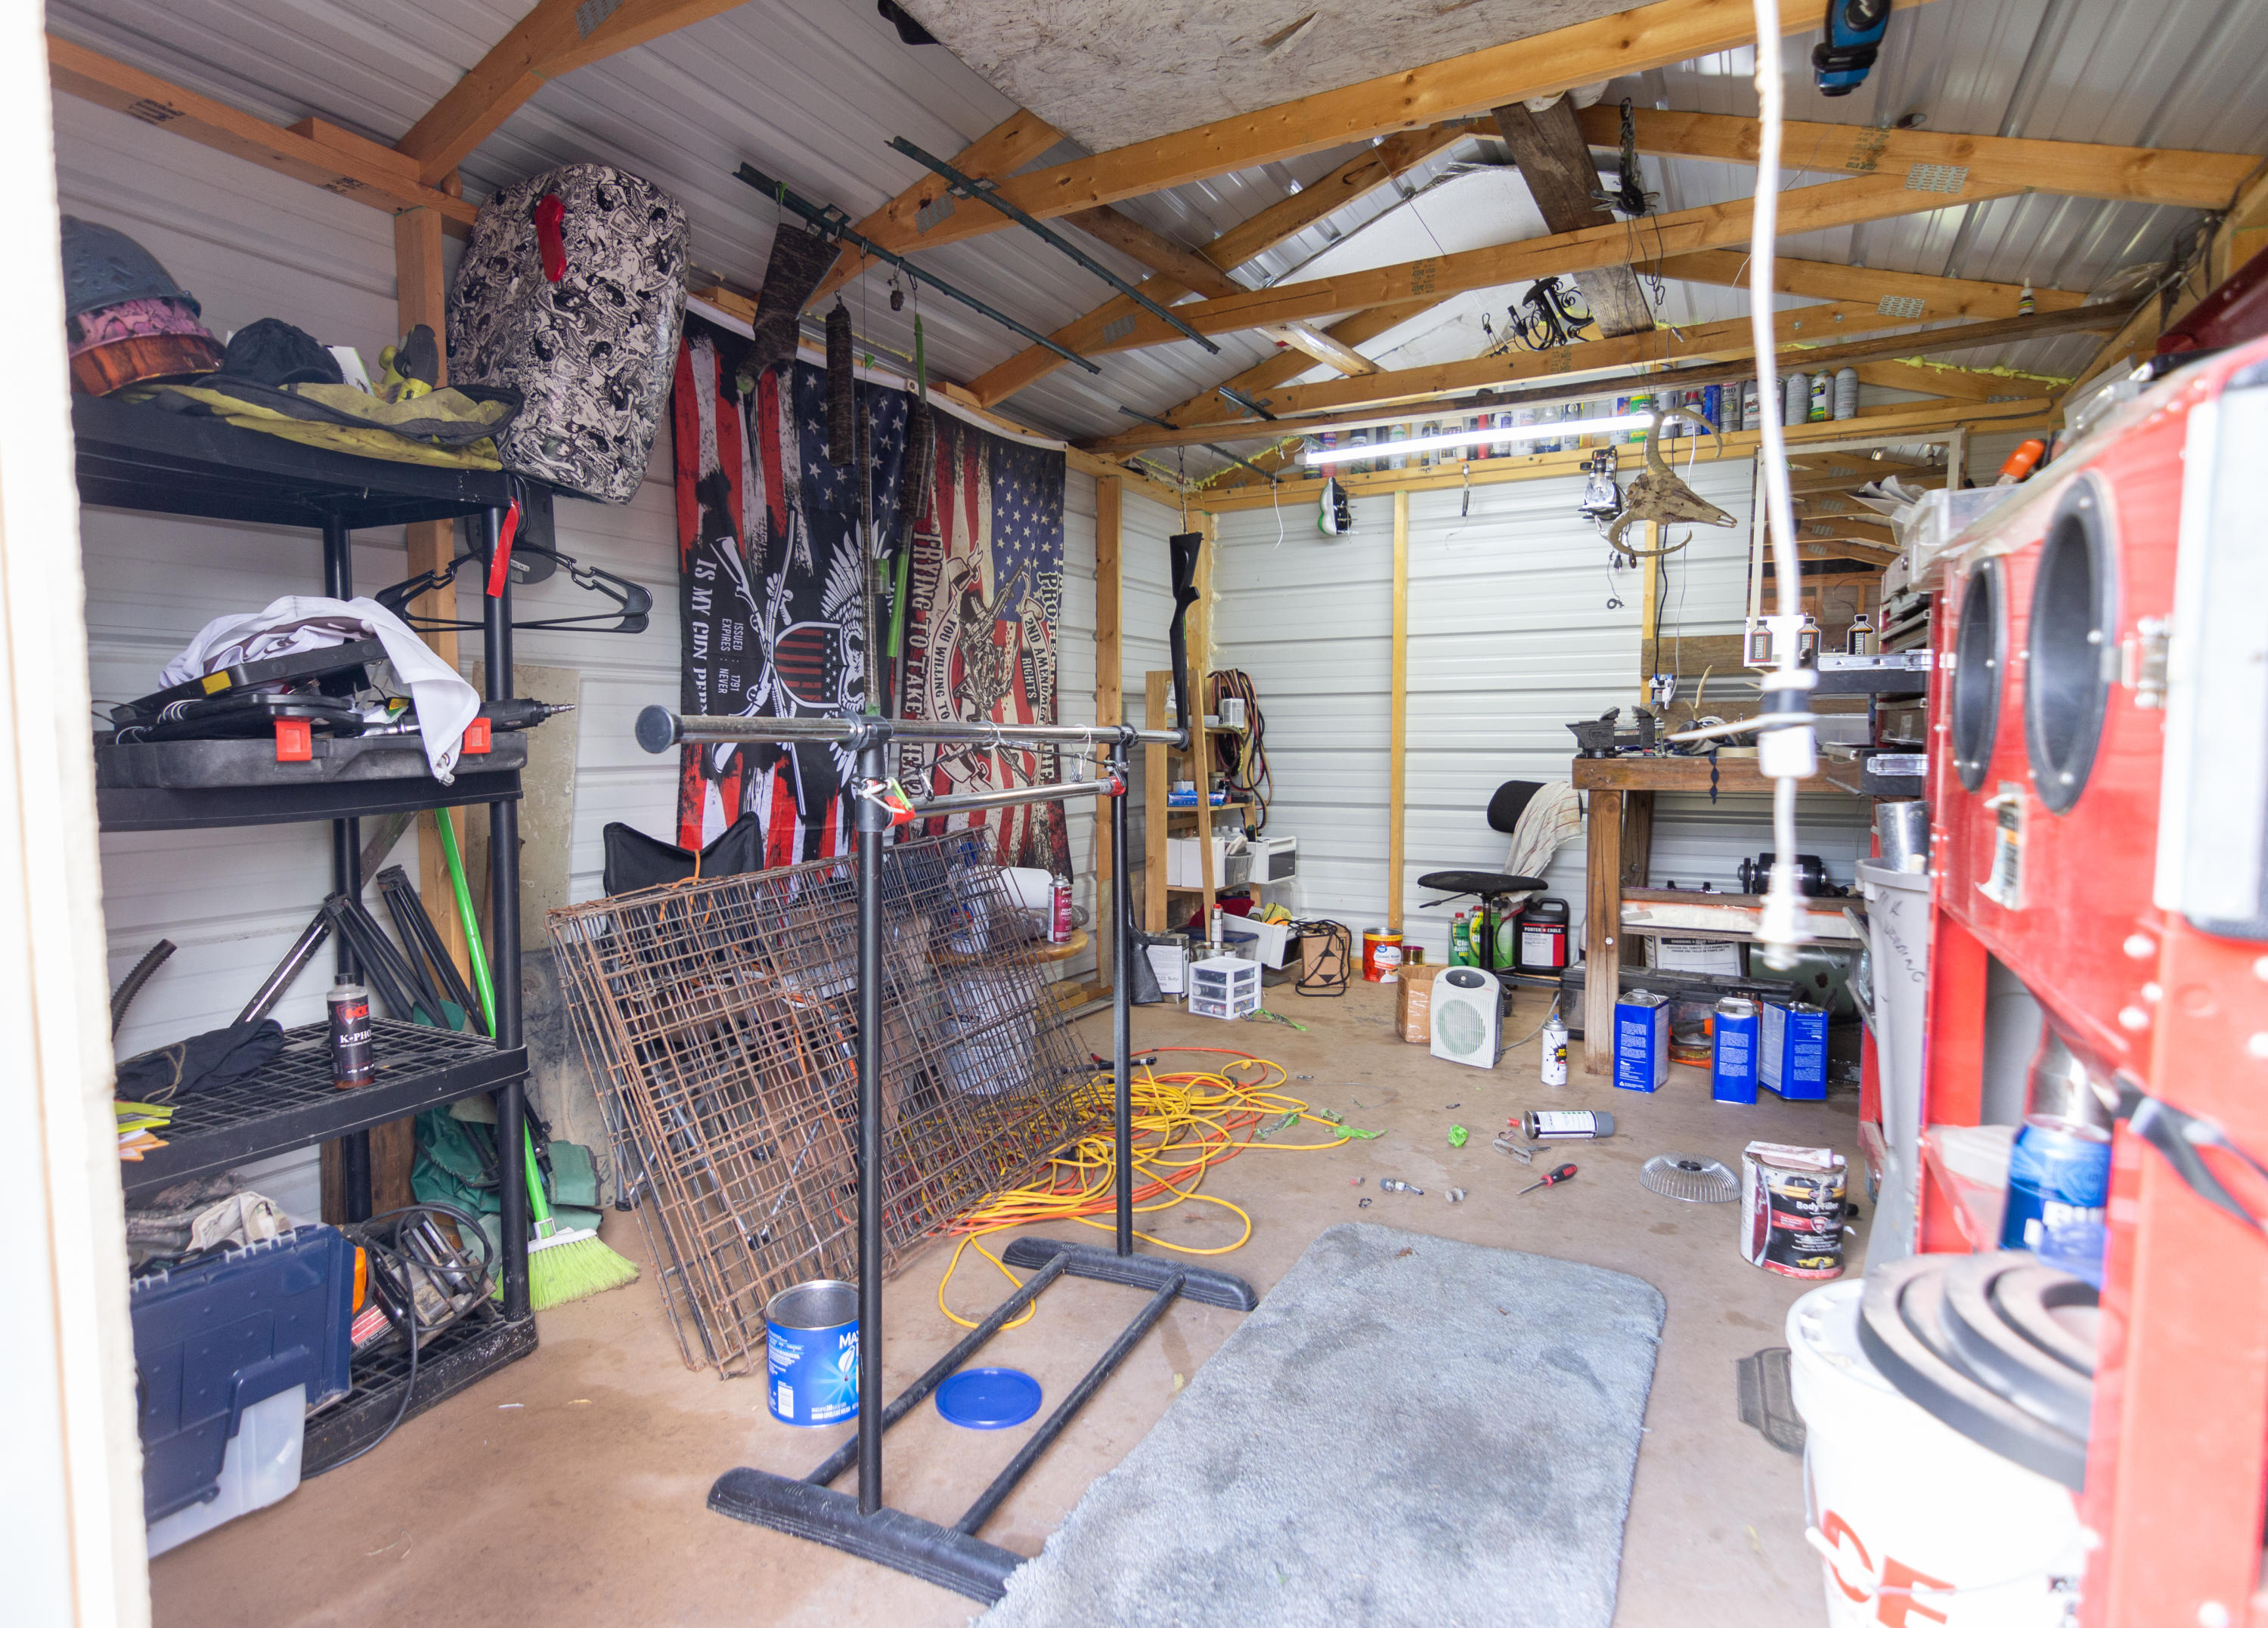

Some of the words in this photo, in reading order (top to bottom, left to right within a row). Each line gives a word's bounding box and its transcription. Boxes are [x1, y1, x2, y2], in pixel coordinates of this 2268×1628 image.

[694, 558, 717, 581] IS
[912, 532, 942, 610] TRYING
[692, 586, 713, 616] MY
[720, 618, 732, 652] EXPIRES
[733, 622, 744, 651] ISSUED
[909, 620, 929, 647] TO
[941, 615, 957, 642] YOU
[718, 668, 730, 694] NEVER
[730, 674, 740, 692] 1791
[934, 647, 947, 698] WILLING
[1021, 657, 1036, 699] RIGHTS
[1024, 618, 1041, 642] 2ND
[1034, 648, 1052, 723] AMENDMEN
[905, 657, 926, 716] TAKE
[939, 701, 950, 720] TO
[901, 743, 925, 794] HEM?
[1796, 1200, 1818, 1212] Body
